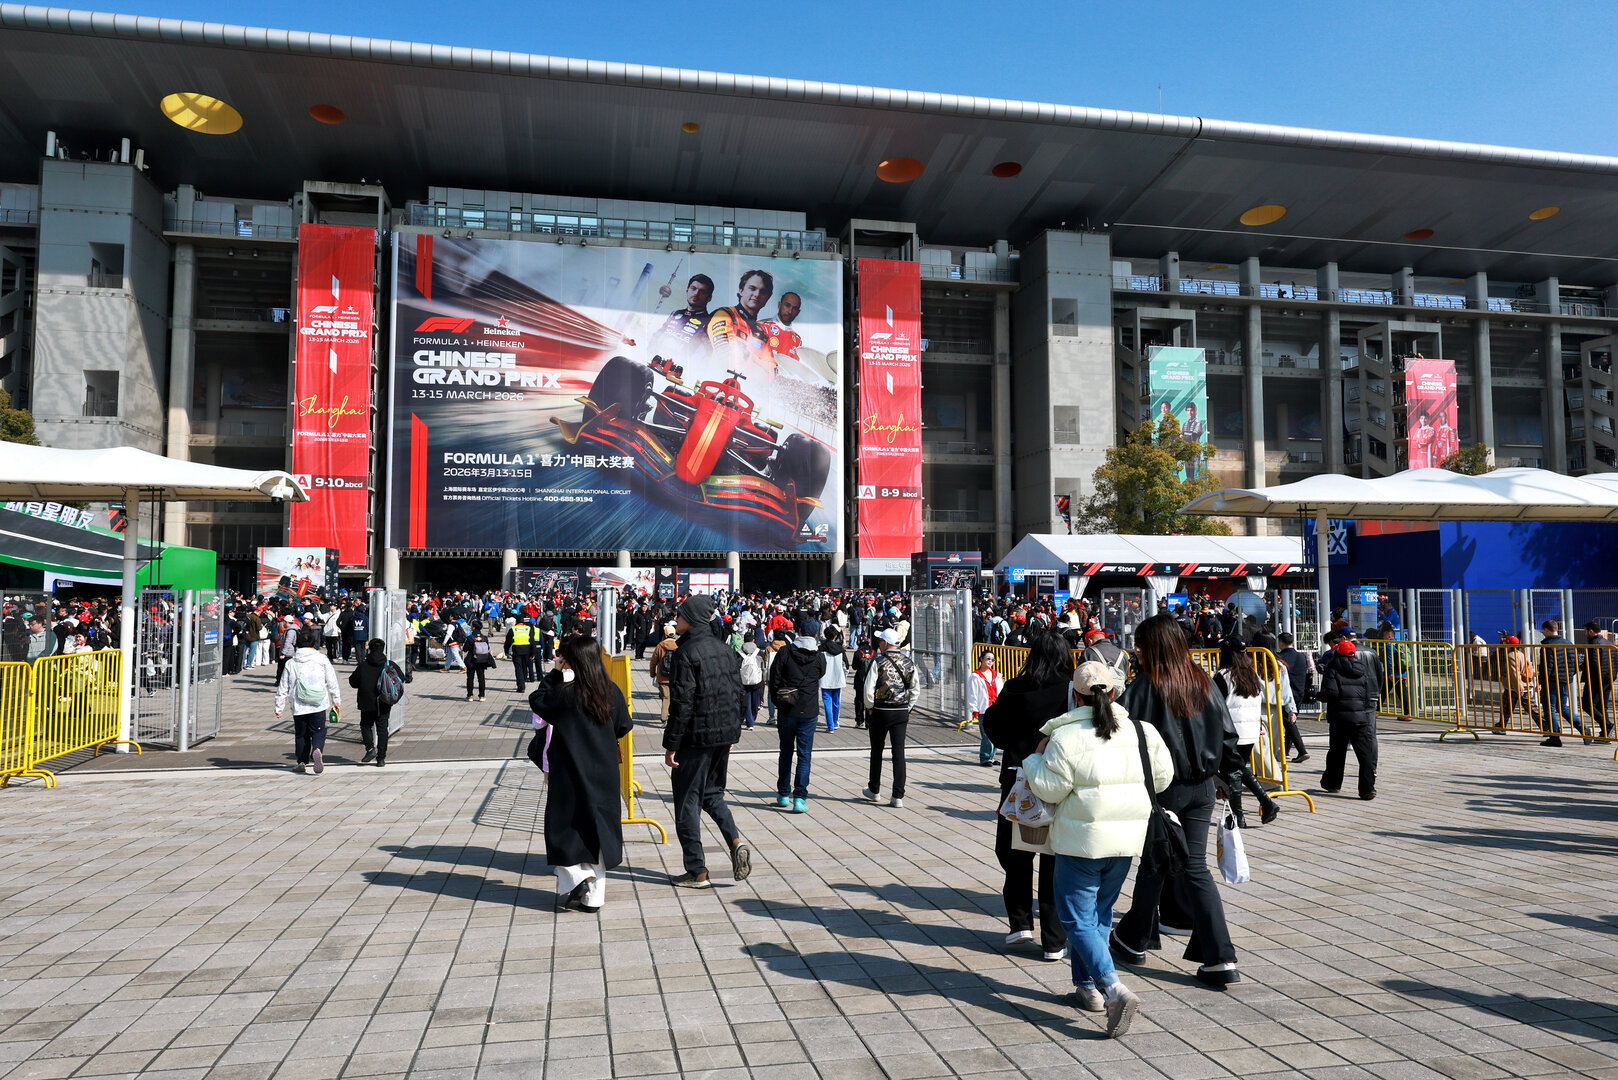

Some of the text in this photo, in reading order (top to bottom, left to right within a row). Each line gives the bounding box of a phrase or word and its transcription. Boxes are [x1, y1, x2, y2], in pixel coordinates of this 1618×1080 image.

[311, 320, 358, 329] CHINESE
[300, 328, 368, 338] GRAND PRIX
[484, 328, 520, 336] Heineken
[476, 340, 525, 348] HEINEKEN
[870, 346, 909, 354] CHINESE
[413, 350, 516, 368] CHINESE
[862, 352, 917, 362] GRAND PRIX
[412, 368, 562, 388] GRAND PRIX
[412, 390, 524, 401] 13-15 MARCH 2026
[300, 394, 367, 428] Shanghai
[863, 413, 918, 443] Shanghai
[444, 452, 523, 465] FORMULA
[444, 467, 532, 478] 2026年3月13-15日
[298, 476, 308, 487] A
[863, 487, 873, 497] A
[881, 488, 899, 497] 8-9
